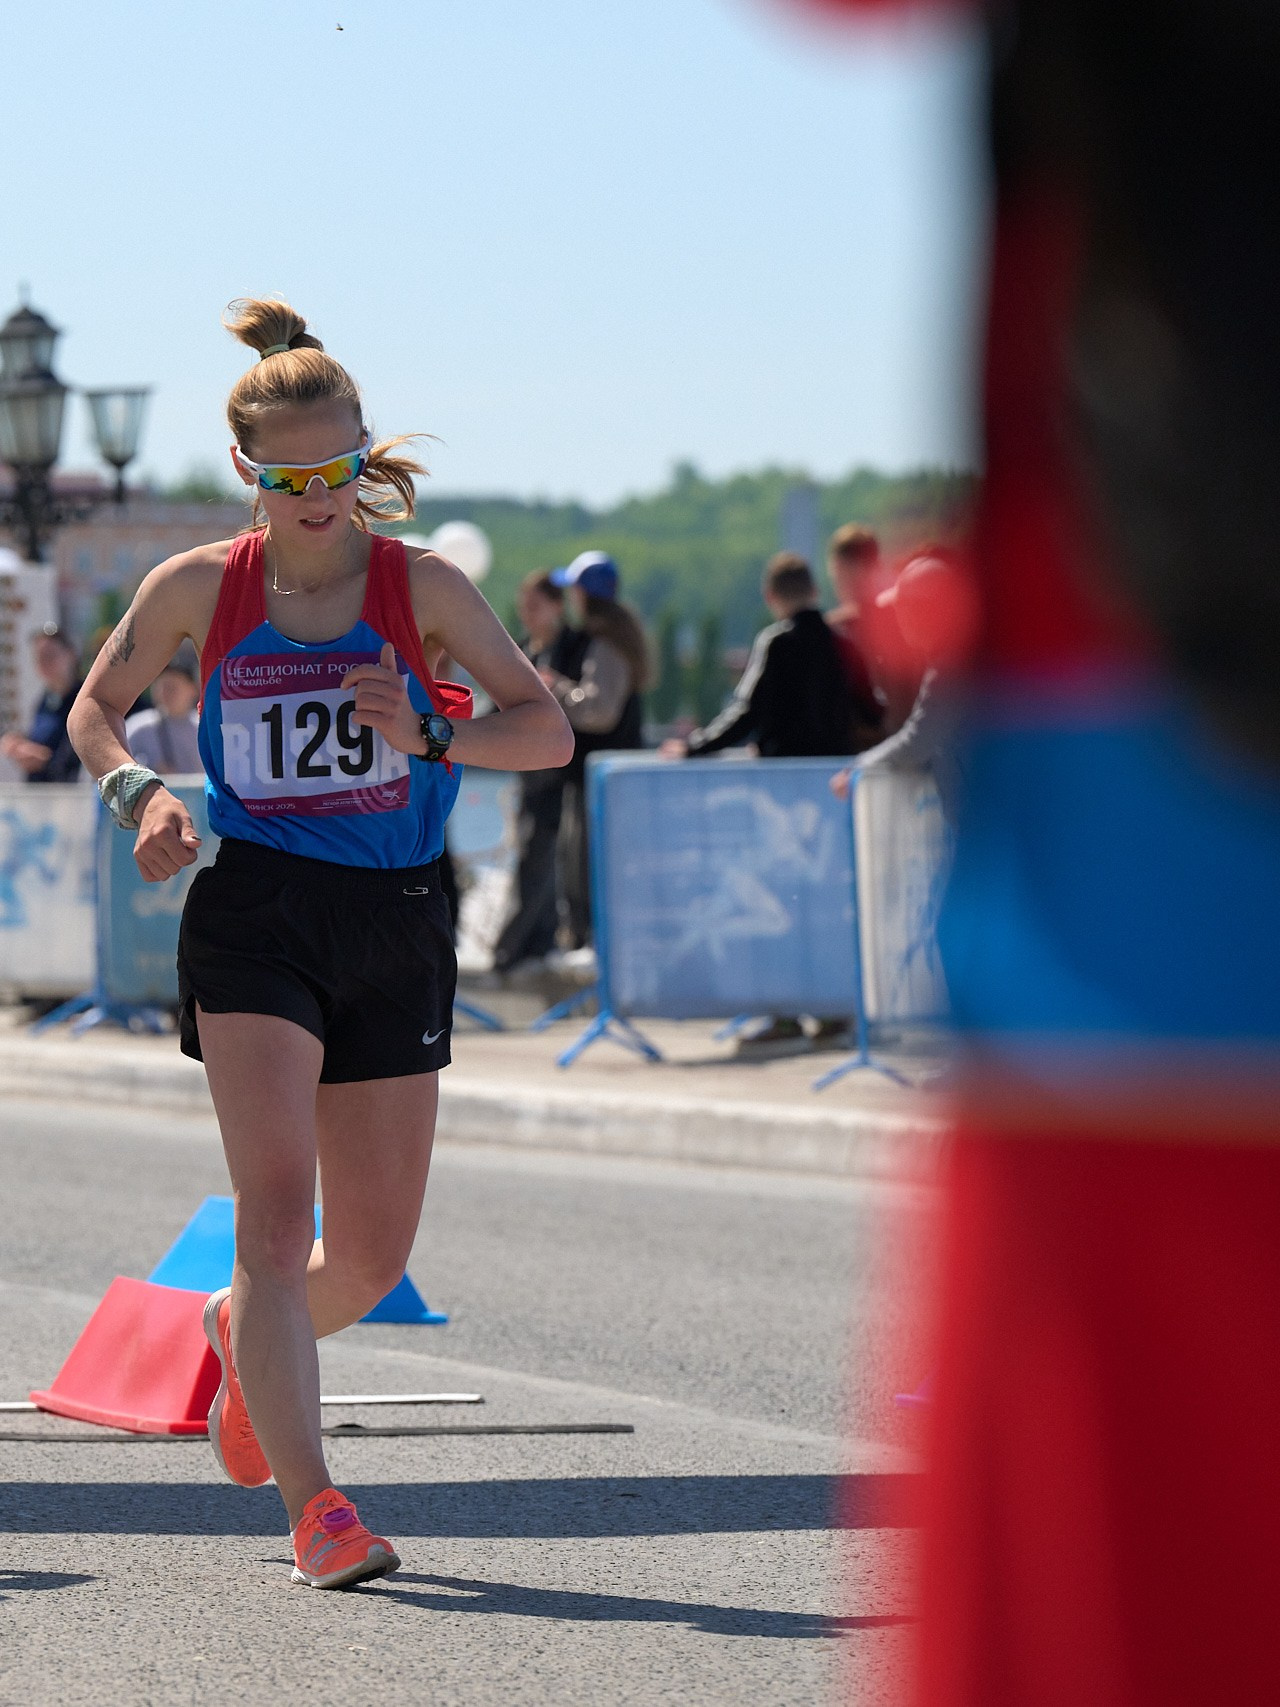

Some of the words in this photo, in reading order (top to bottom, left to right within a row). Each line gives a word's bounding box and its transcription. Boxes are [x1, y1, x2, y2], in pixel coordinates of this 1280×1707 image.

[227, 663, 323, 678] ЧЕМПИОНАТ
[243, 676, 282, 687] ходьбе
[261, 701, 373, 778] 129
[246, 803, 274, 811] КИНСК
